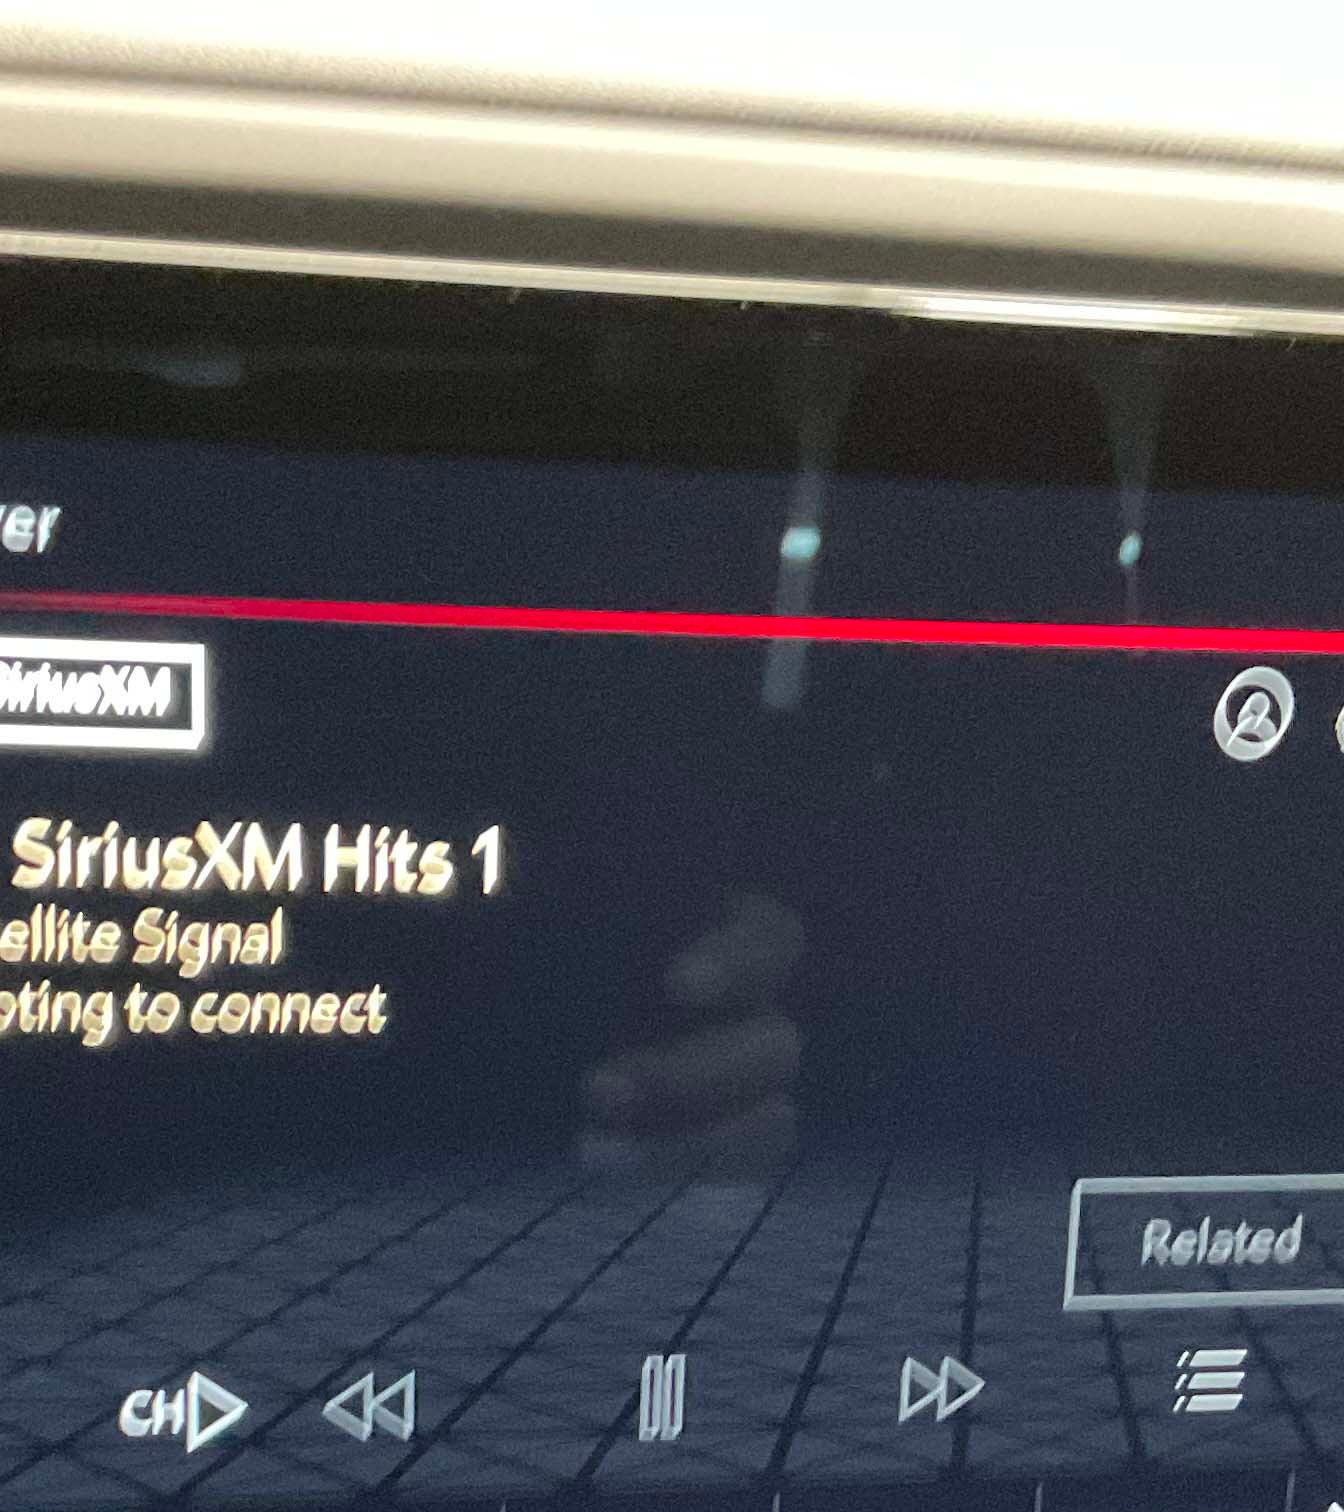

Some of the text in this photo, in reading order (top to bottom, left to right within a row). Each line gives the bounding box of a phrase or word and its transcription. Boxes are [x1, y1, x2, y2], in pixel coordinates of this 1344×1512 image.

[12, 817, 303, 891] SiriusXM
[324, 824, 454, 895] Hits
[472, 825, 500, 894] 1
[133, 907, 283, 978] Signal
[124, 983, 180, 1033] to
[191, 984, 387, 1034] connect
[1142, 1214, 1303, 1265] Related
[119, 1389, 184, 1436] CH
